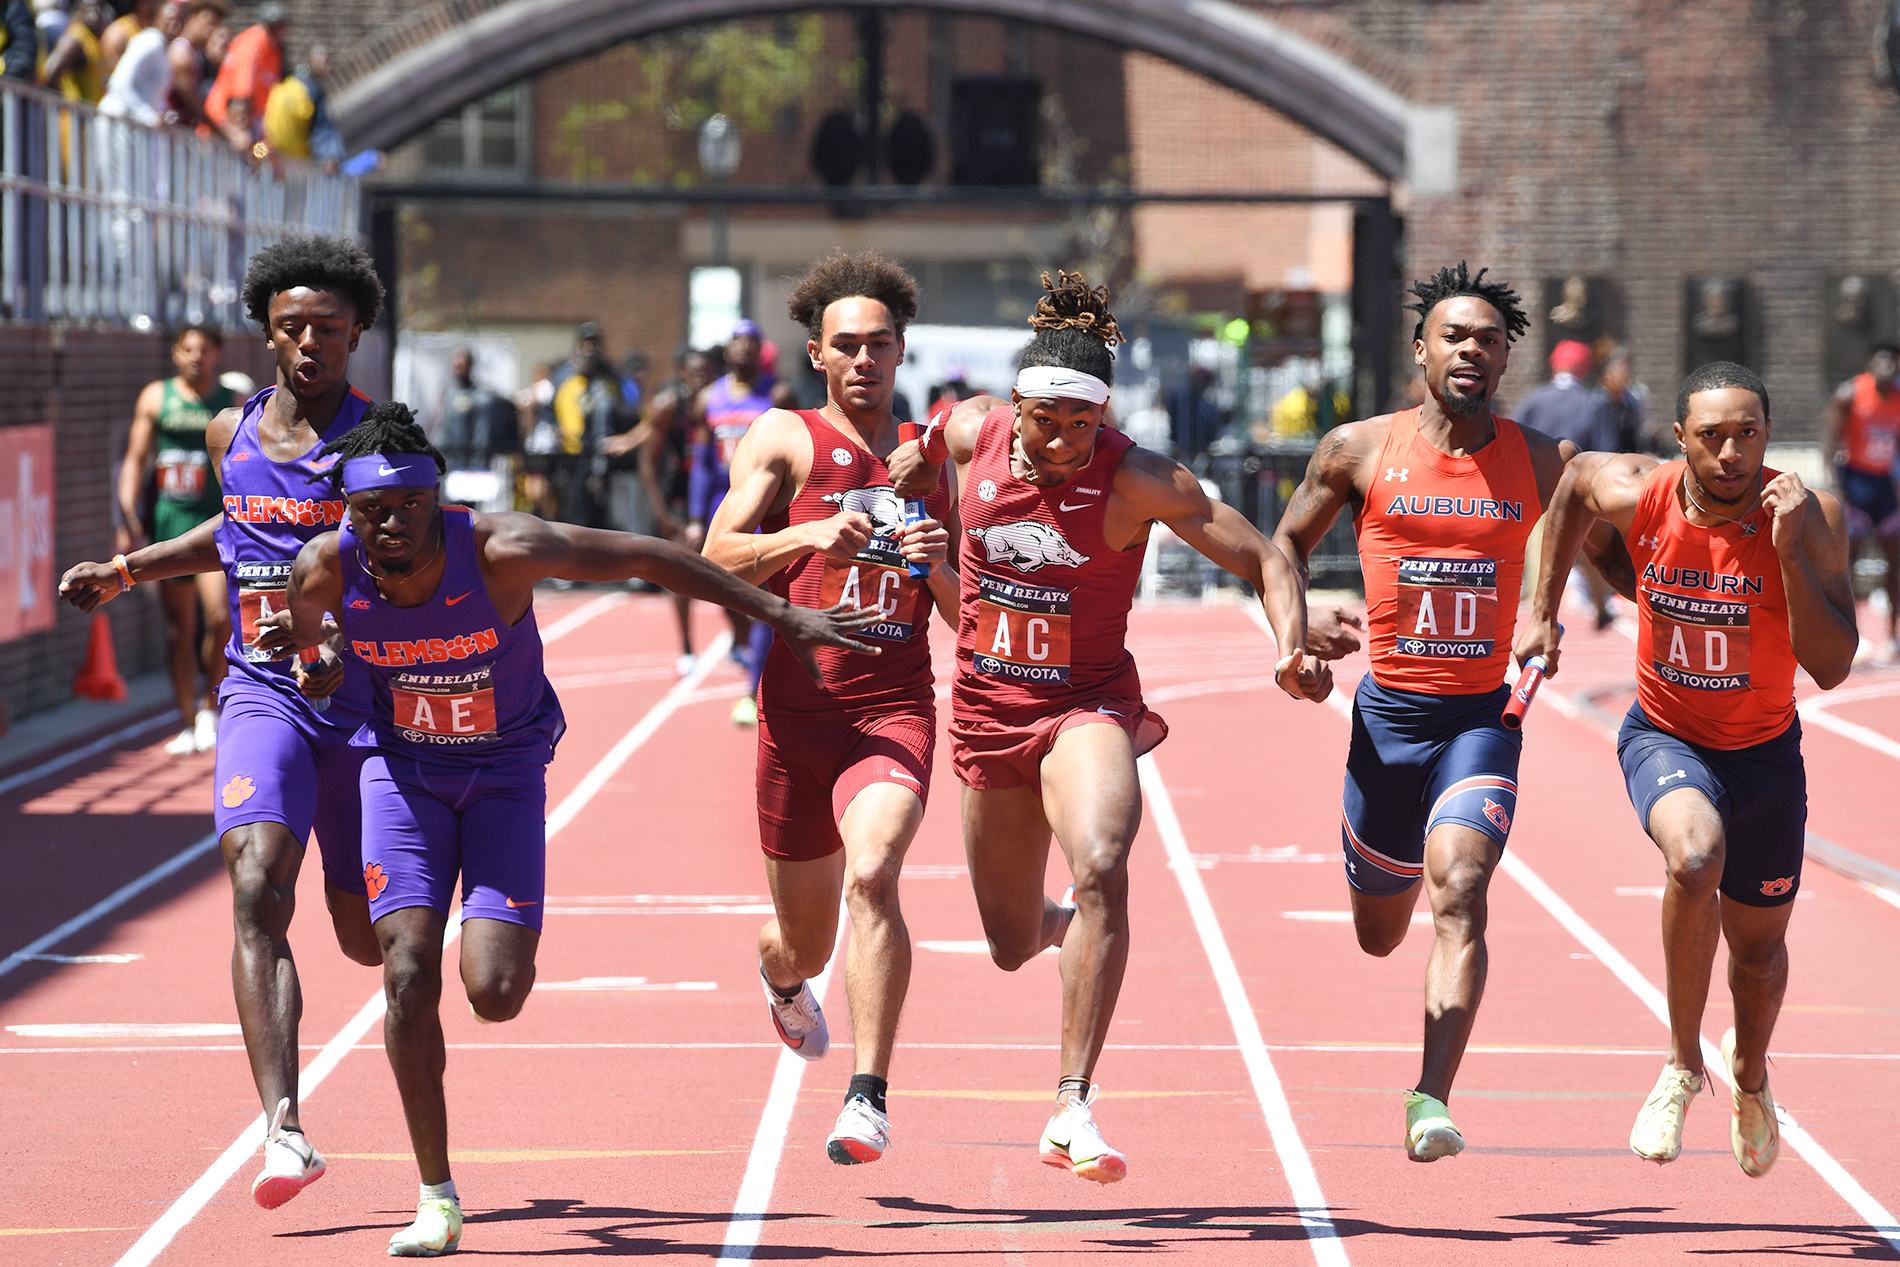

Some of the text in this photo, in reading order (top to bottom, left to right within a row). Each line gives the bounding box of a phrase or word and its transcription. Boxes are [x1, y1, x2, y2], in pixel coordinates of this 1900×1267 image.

[1385, 495, 1522, 521] AUBURN
[868, 539, 902, 555] RELA
[237, 565, 270, 577] PENN
[1400, 560, 1495, 574] PENN RELAYS
[1642, 562, 1764, 595] AUBURN
[838, 565, 900, 617] A C
[980, 577, 1069, 602] PENN RELAYS
[349, 599, 371, 610] ACC
[1414, 591, 1477, 636] A D
[1650, 592, 1747, 615] PENN RELAYS
[861, 623, 903, 637] YOTA
[990, 611, 1049, 661] A C
[1428, 643, 1486, 656] TOYOTA
[1667, 624, 1728, 671] A D
[398, 668, 490, 685] ENN RELAYS
[1002, 663, 1060, 681] TOYOTA
[1680, 673, 1741, 689] TOYOTA
[412, 696, 475, 732] A E
